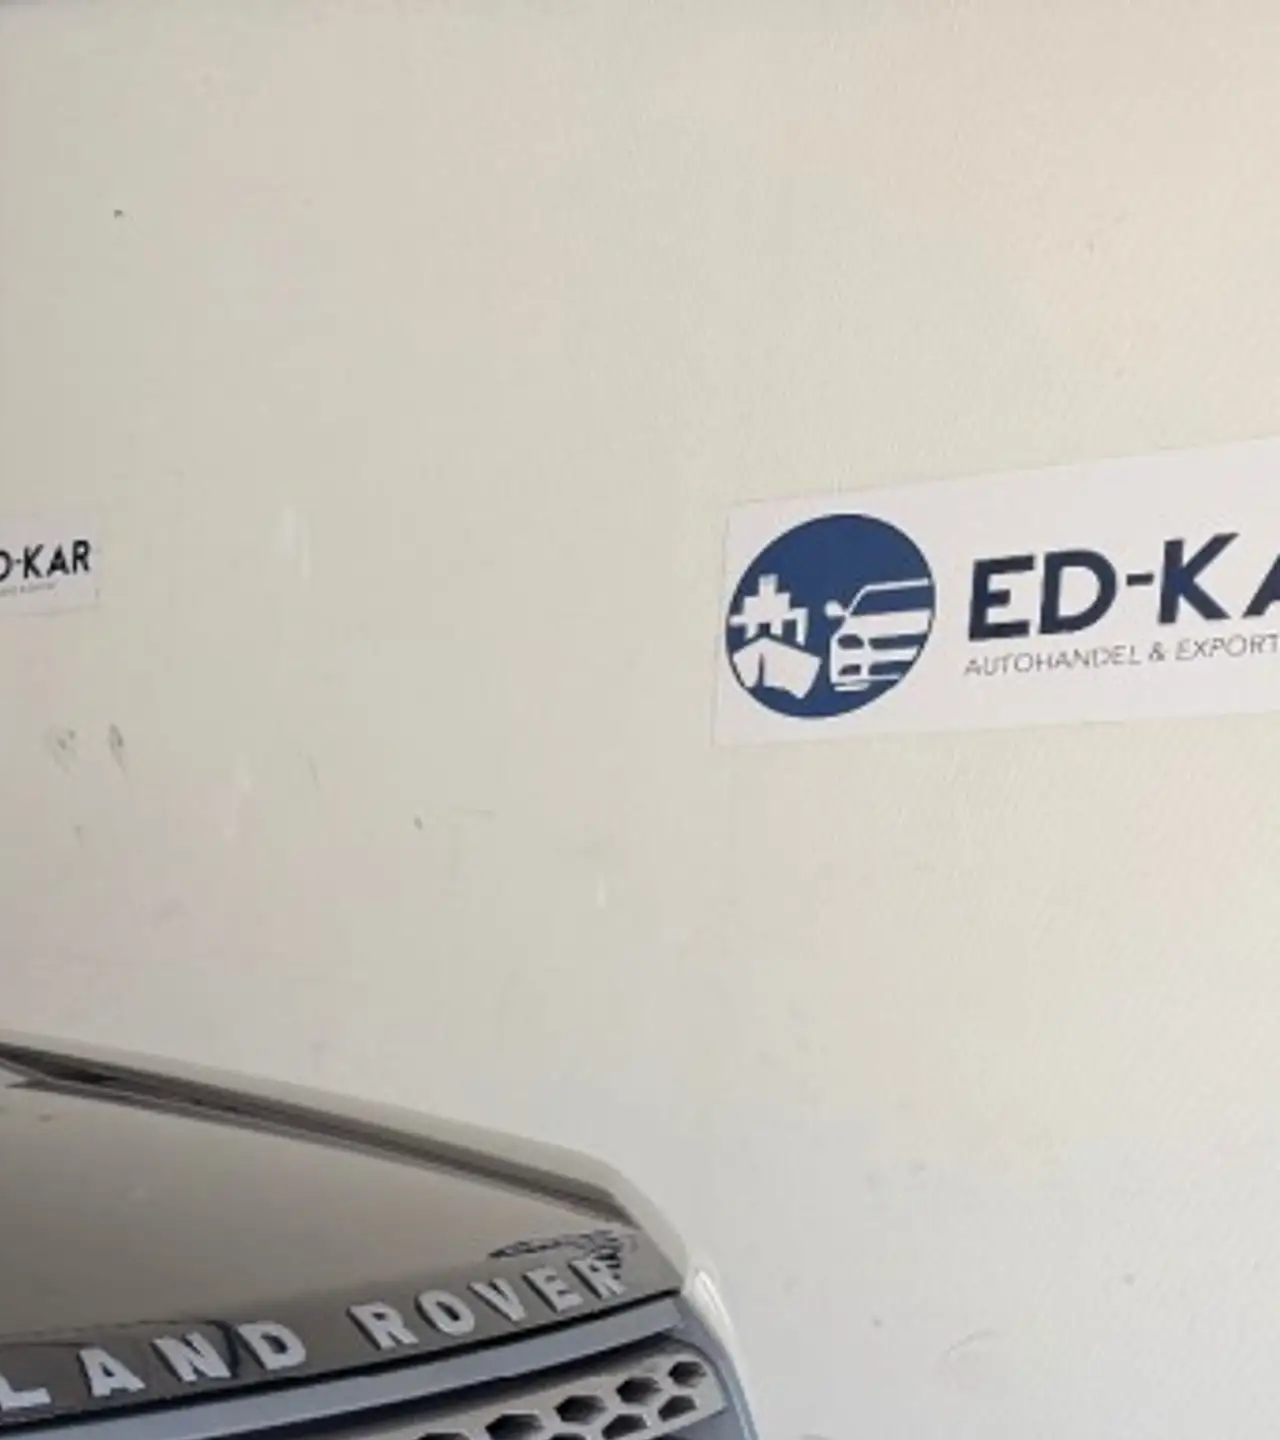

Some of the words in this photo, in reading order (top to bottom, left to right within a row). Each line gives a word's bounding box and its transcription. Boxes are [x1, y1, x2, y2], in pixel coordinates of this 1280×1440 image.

[963, 644, 1143, 678] AUTOHANDEL
[1147, 641, 1167, 663] &
[1174, 632, 1280, 662] EXPORT
[346, 1256, 629, 1351] ROVER
